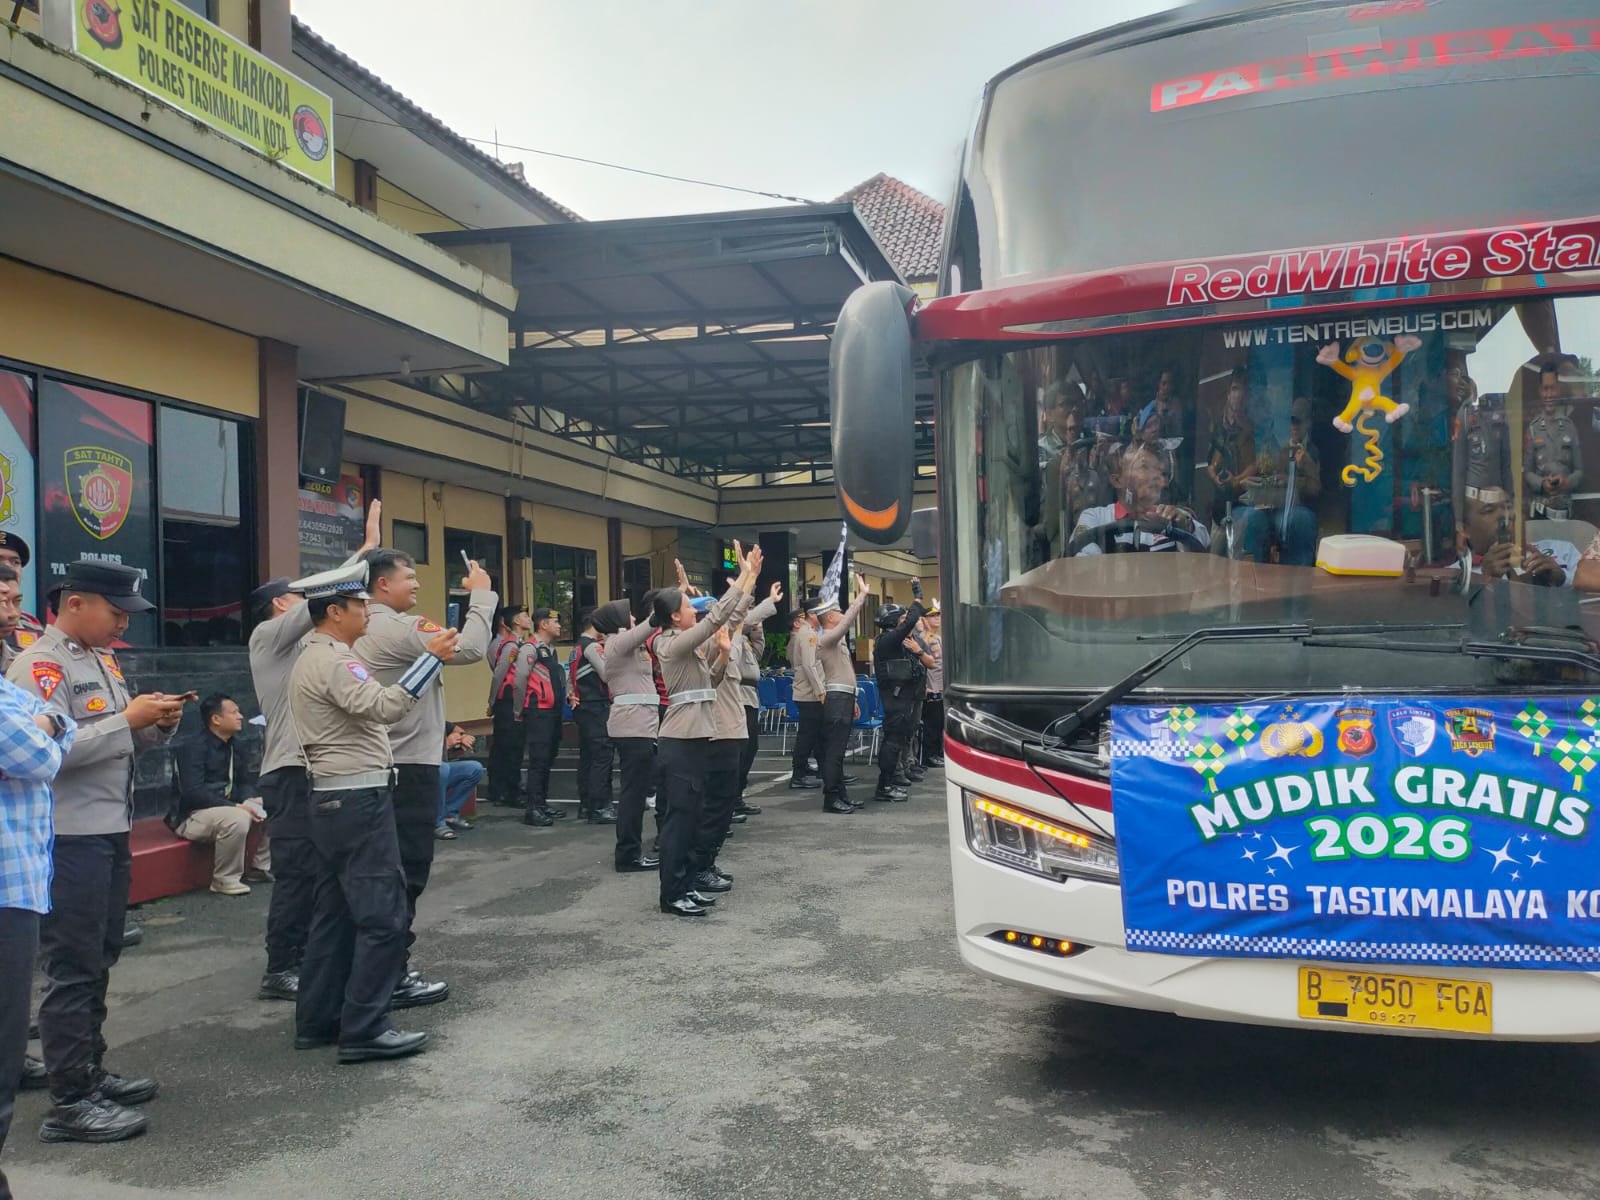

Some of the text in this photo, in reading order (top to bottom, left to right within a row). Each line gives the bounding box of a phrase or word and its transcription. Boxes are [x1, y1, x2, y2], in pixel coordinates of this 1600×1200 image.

[130, 0, 290, 119] SAT RESERSE NARKOBA
[138, 44, 289, 153] POLRES TASIKMALAYA KOTA
[1166, 226, 1600, 306] RedWhite Sta
[1223, 308, 1493, 349] WWW.TENTREMBUS.COM
[74, 450, 124, 467] SAT TAHTI
[1191, 766, 1591, 840] MUDIK GRATIS
[1308, 815, 1469, 859] 2026
[1166, 879, 1289, 913] POLRES
[1306, 885, 1548, 919] TASIKMALAYA
[1307, 971, 1488, 1017] B 7950 FGA
